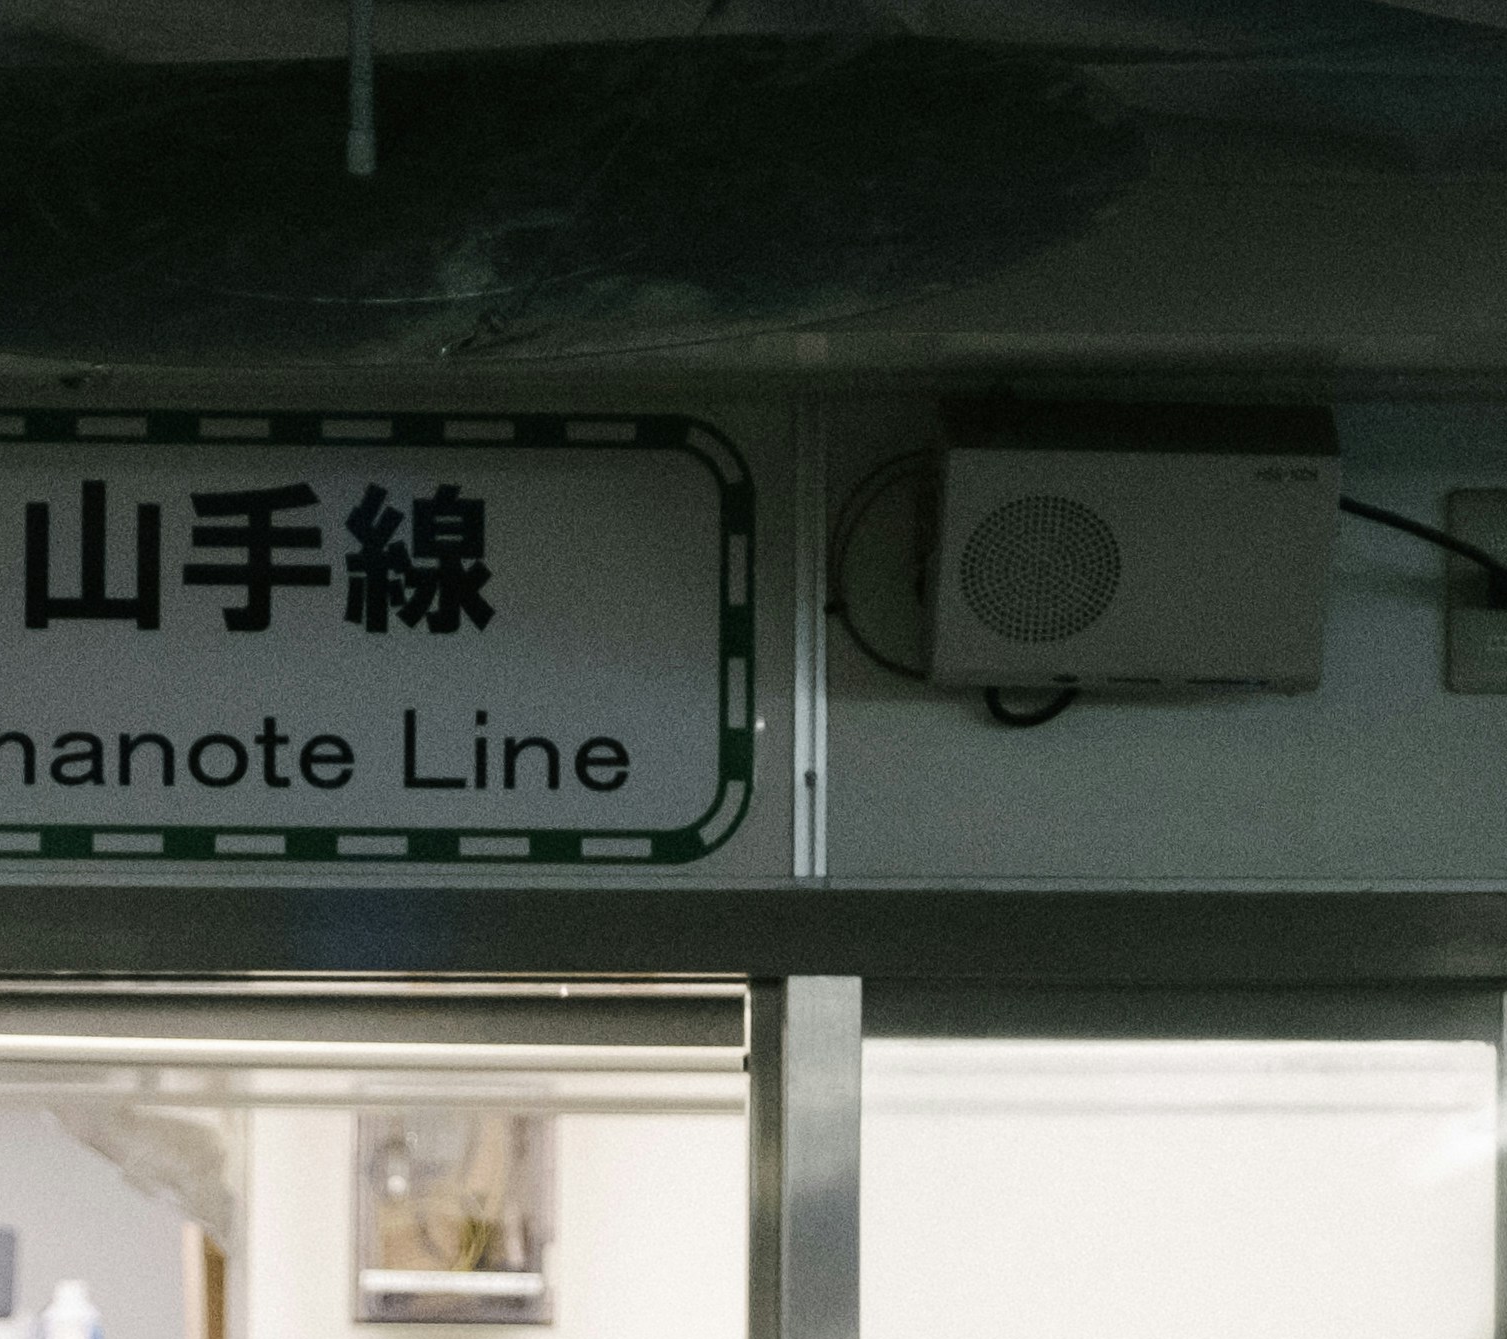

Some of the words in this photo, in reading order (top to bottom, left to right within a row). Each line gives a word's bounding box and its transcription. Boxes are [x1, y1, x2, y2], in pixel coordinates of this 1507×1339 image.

[22, 478, 495, 635] 山手線
[402, 709, 632, 793] Line
